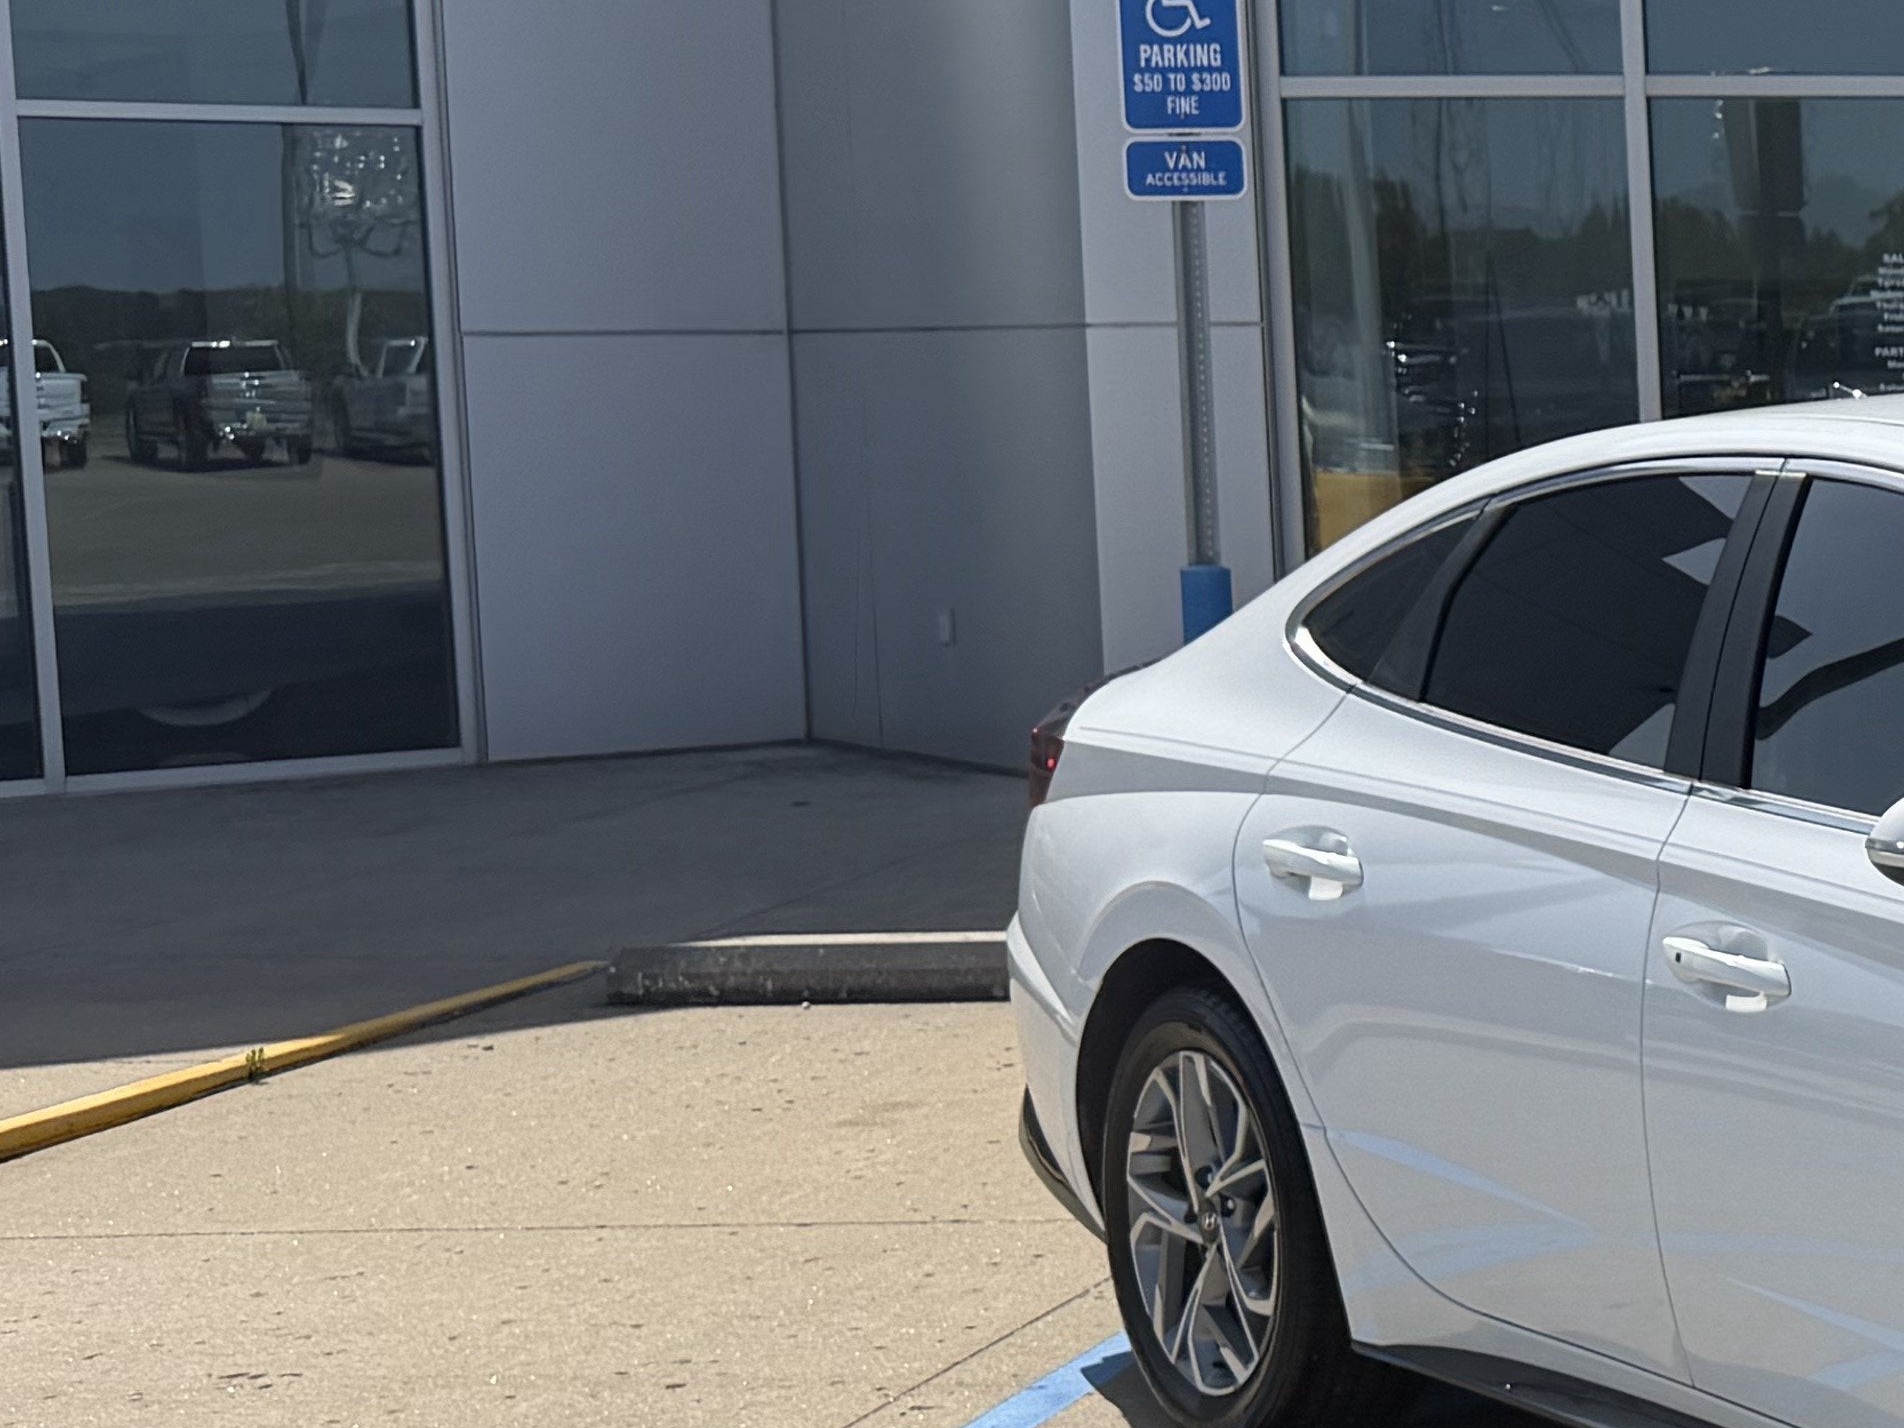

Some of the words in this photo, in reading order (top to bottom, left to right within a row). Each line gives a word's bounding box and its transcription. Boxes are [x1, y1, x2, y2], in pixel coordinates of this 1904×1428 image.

[1138, 43, 1222, 68] PARKING
[1132, 74, 1163, 93] $50
[1167, 73, 1187, 93] TO
[1191, 72, 1231, 92] $300
[1166, 95, 1200, 115] FINE
[1164, 151, 1206, 170] VAN
[1145, 171, 1227, 187] ACCESSIBLE
